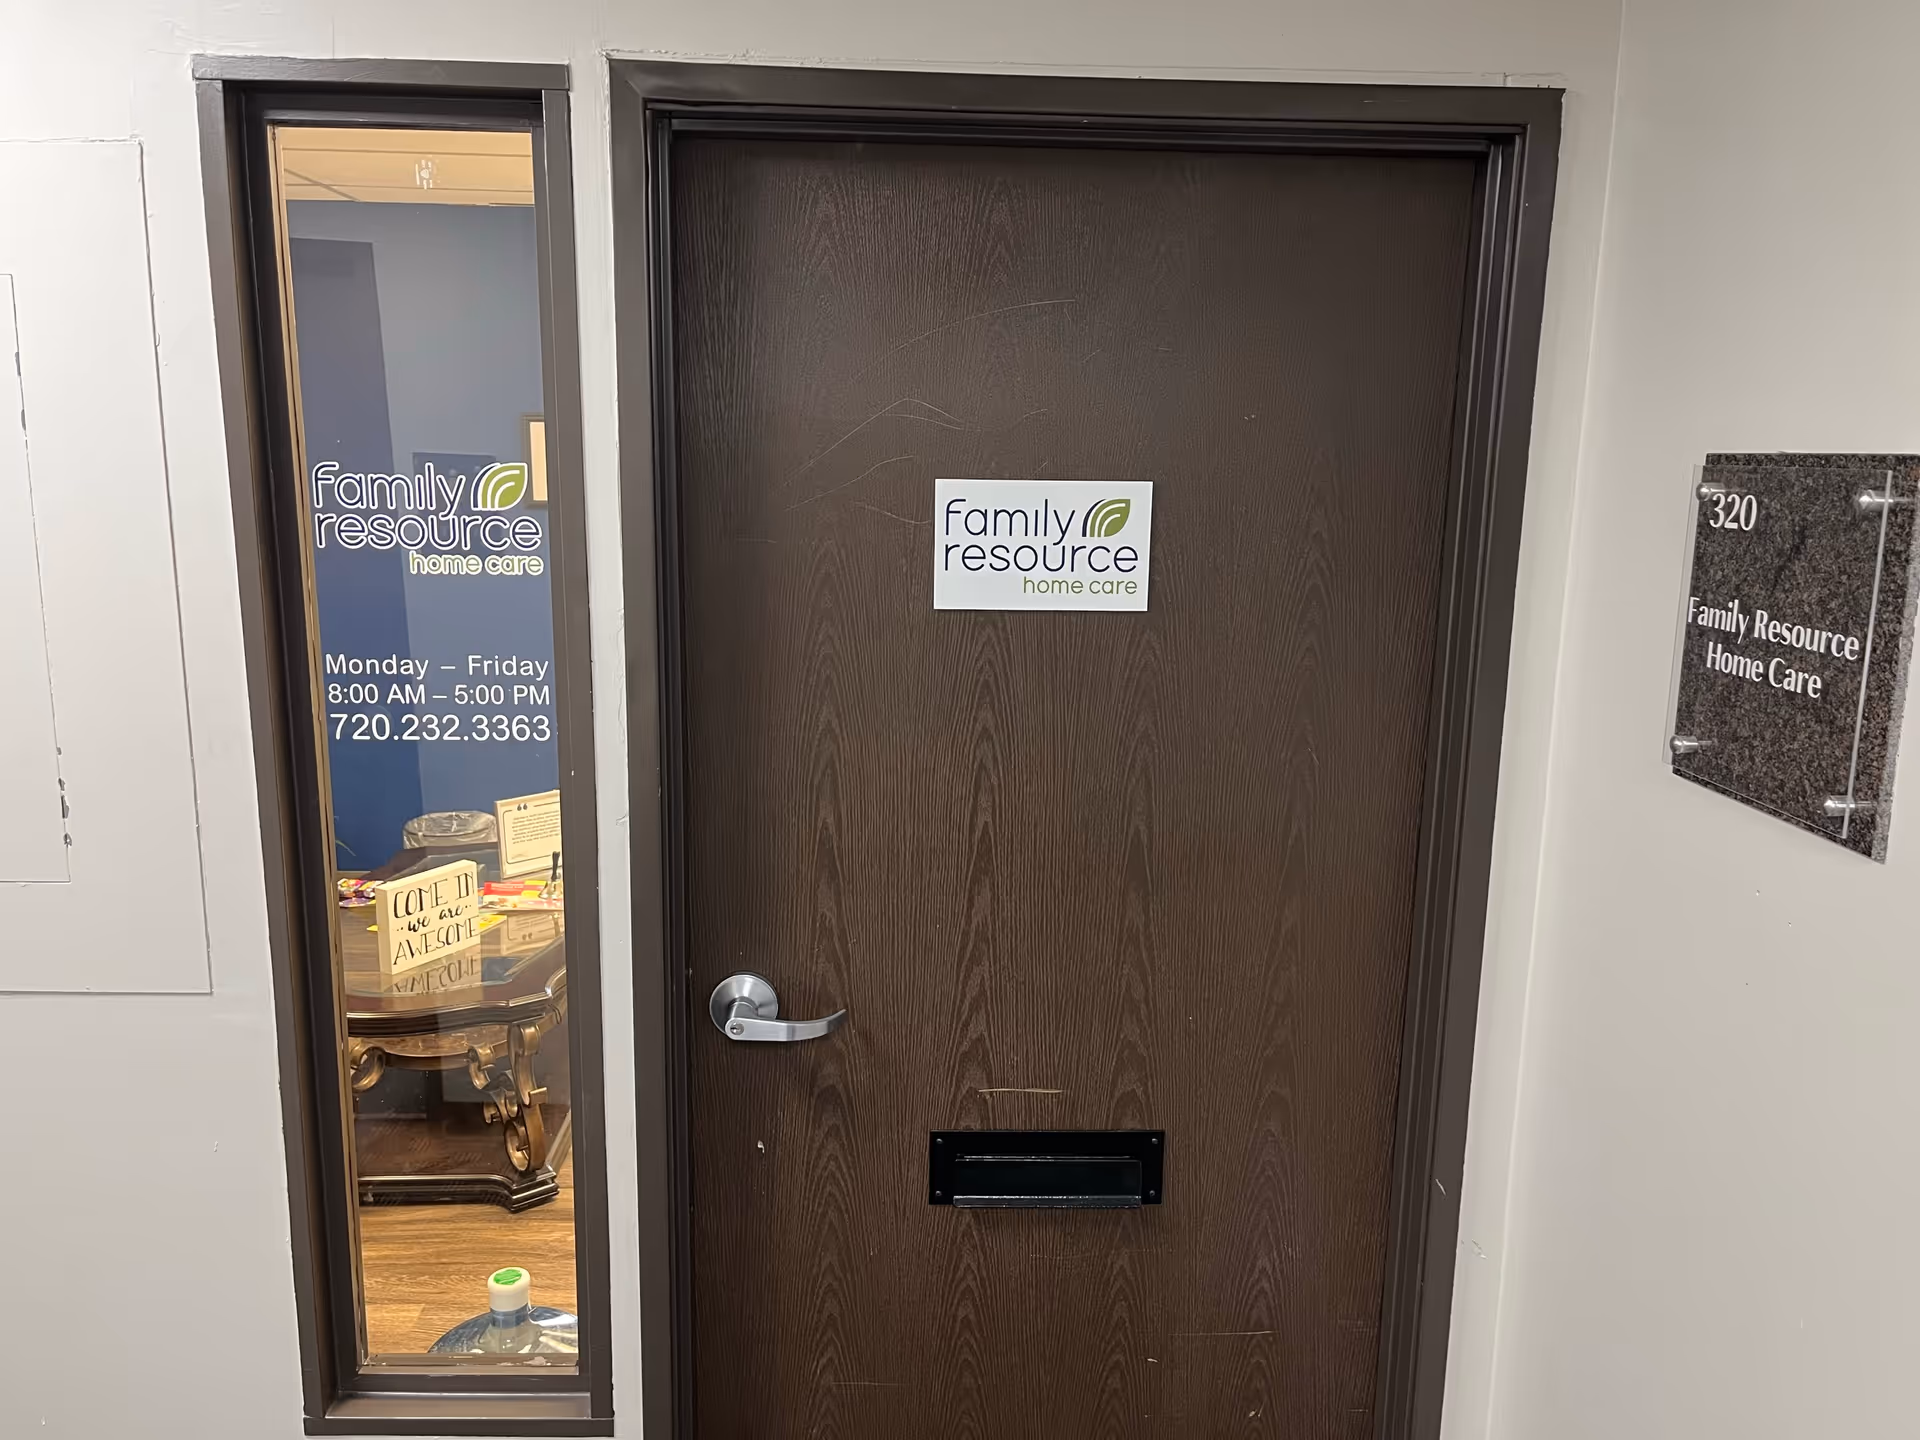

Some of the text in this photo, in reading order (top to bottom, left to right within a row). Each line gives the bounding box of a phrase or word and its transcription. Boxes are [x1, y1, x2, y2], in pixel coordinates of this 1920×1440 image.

[312, 461, 467, 519] family
[945, 498, 1076, 546] family
[1709, 493, 1757, 531] 320
[315, 513, 542, 551] resource
[409, 550, 544, 575] home care
[944, 544, 1139, 573] resource
[1023, 576, 1138, 595] home care
[1687, 596, 1860, 661] Family Resource
[325, 654, 429, 680] Monday
[468, 655, 549, 681] Friday
[1706, 641, 1822, 698] Home Care
[328, 683, 379, 704] 8:00
[386, 683, 426, 704] AM
[454, 684, 505, 705] 5:00
[513, 685, 550, 706] PM
[330, 713, 551, 741] 720.232.3363
[393, 871, 475, 919] COME IN
[392, 914, 480, 966] AWESOME
